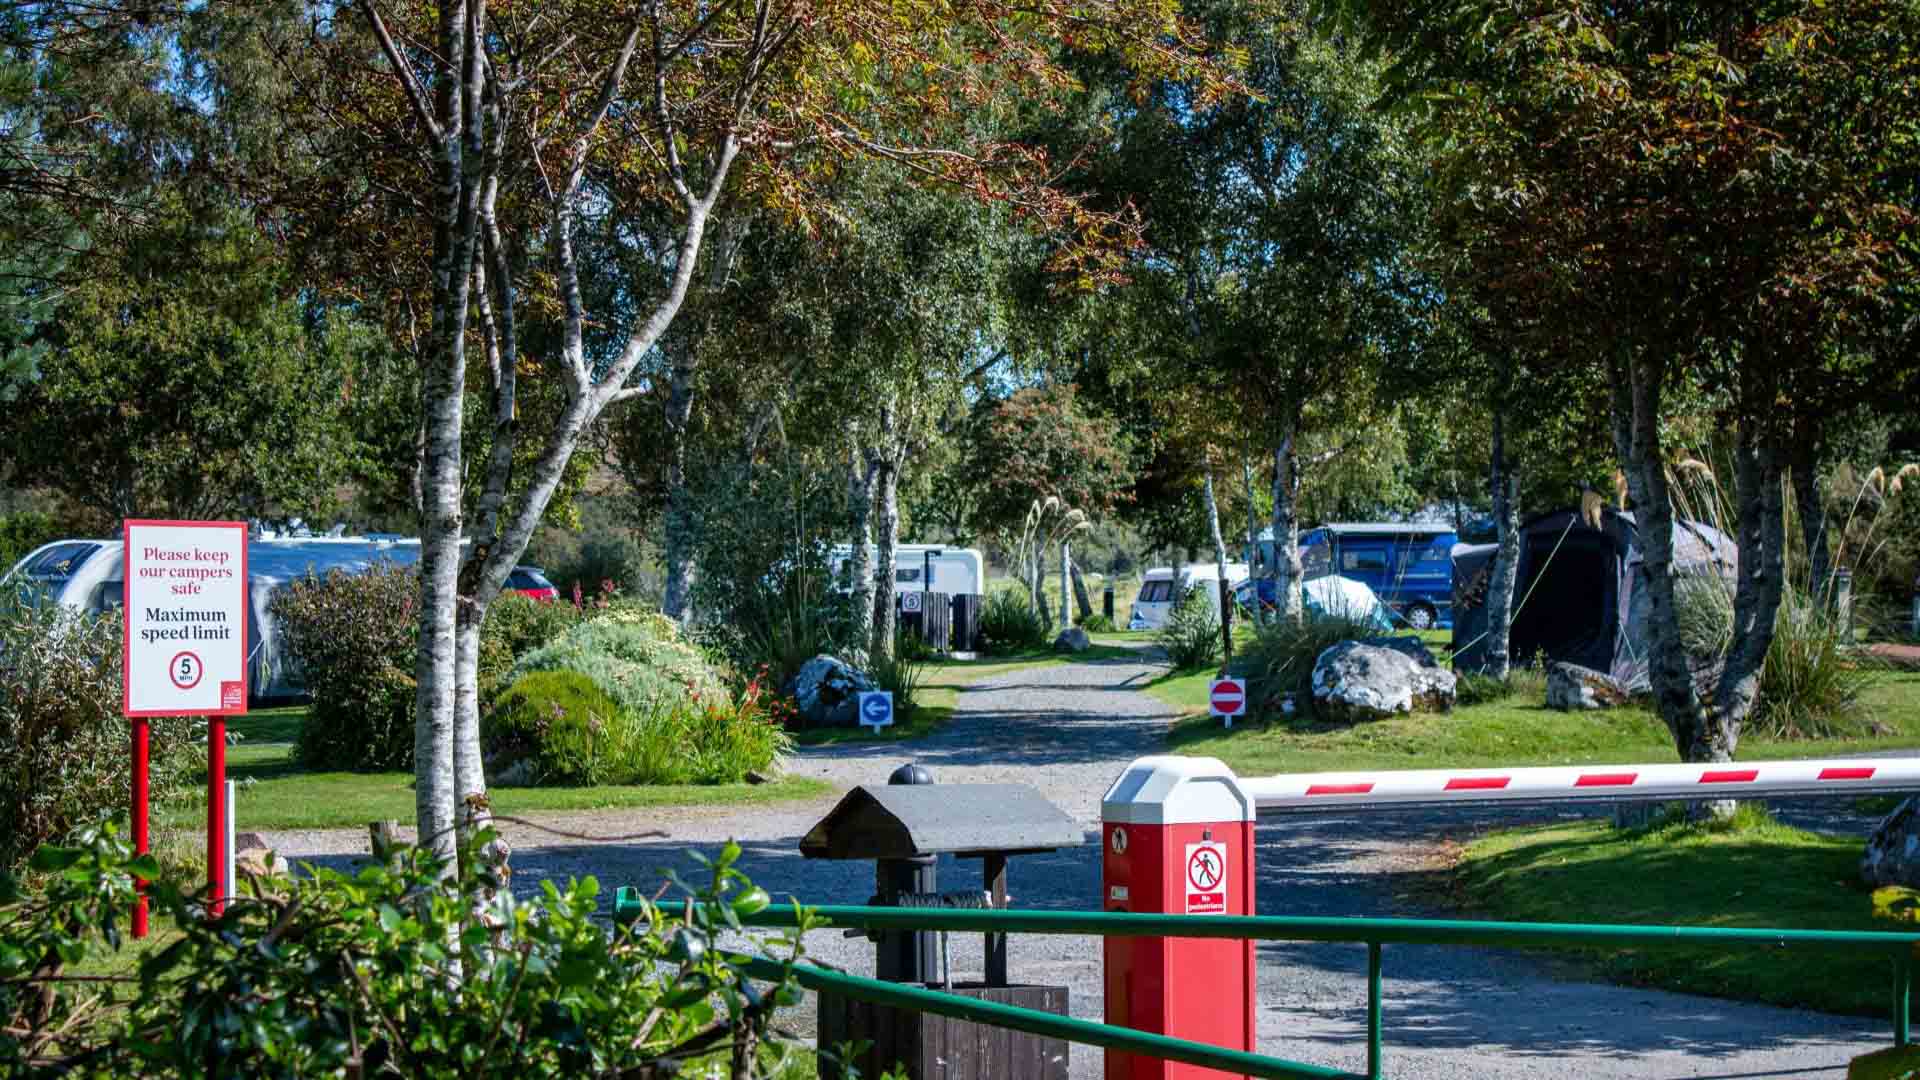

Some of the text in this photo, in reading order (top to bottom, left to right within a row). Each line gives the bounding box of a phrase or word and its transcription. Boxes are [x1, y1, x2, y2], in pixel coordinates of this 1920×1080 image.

[144, 547, 229, 565] Please keep
[139, 566, 233, 581] our campers
[171, 581, 201, 595] safe
[145, 607, 226, 622] Maximum
[141, 625, 230, 643] speed limit
[180, 658, 191, 674] 5
